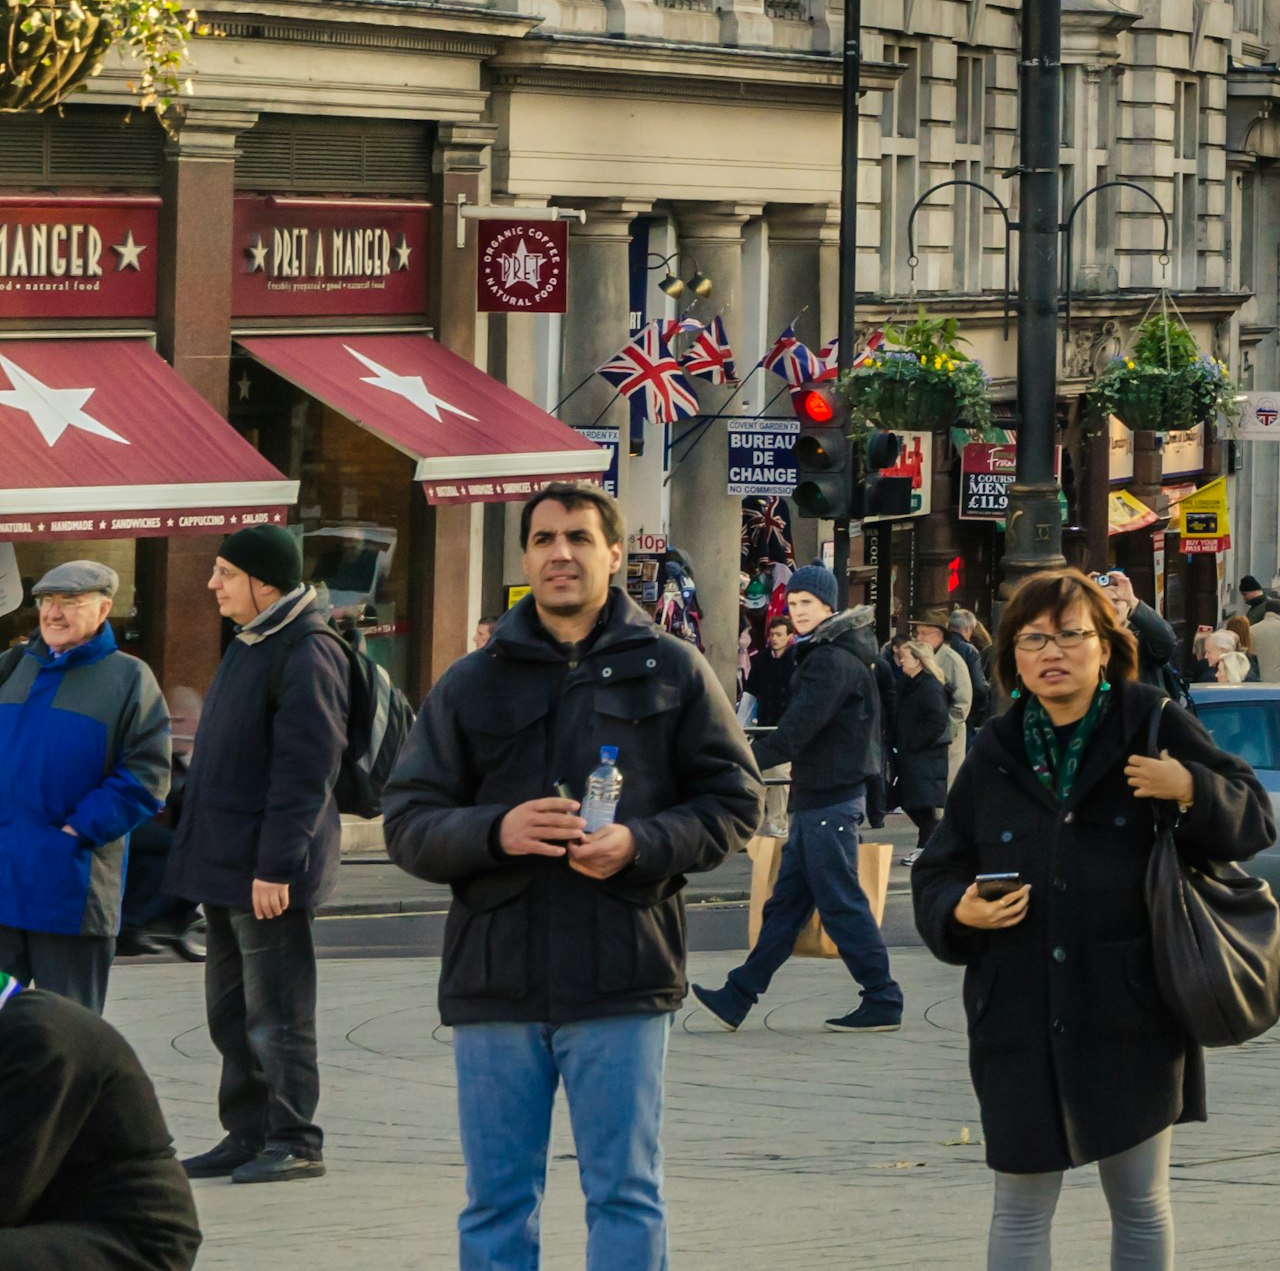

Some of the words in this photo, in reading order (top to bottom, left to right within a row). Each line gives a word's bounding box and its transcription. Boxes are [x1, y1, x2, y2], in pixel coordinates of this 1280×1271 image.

[273, 228, 309, 277] PRET
[315, 228, 325, 277] A
[332, 228, 391, 277] MANGER
[484, 226, 524, 263] ORGANIC
[528, 228, 560, 264] COFFEE
[501, 253, 544, 282] PRET
[25, 281, 69, 290] natural
[74, 281, 100, 290] food
[326, 281, 342, 291] good
[371, 280, 385, 289] food
[486, 277, 532, 306] NATURAL
[534, 277, 558, 303] FOOD
[729, 421, 757, 429] COVENT
[759, 422, 788, 430] GARDEN
[730, 433, 797, 450] BUREAU
[752, 450, 775, 466] DE
[729, 467, 797, 483] CHANGE
[969, 474, 976, 482] 2
[729, 485, 742, 494] NO
[744, 486, 792, 495] COMMISSIO
[968, 482, 1009, 495] MEN
[967, 495, 1009, 509] £11.9
[51, 520, 94, 532] HANDMADE
[111, 517, 161, 530] SANDWICHES
[179, 514, 225, 527] CAPPUCCINO
[242, 512, 269, 524] SALADS
[637, 535, 667, 553] 10p
